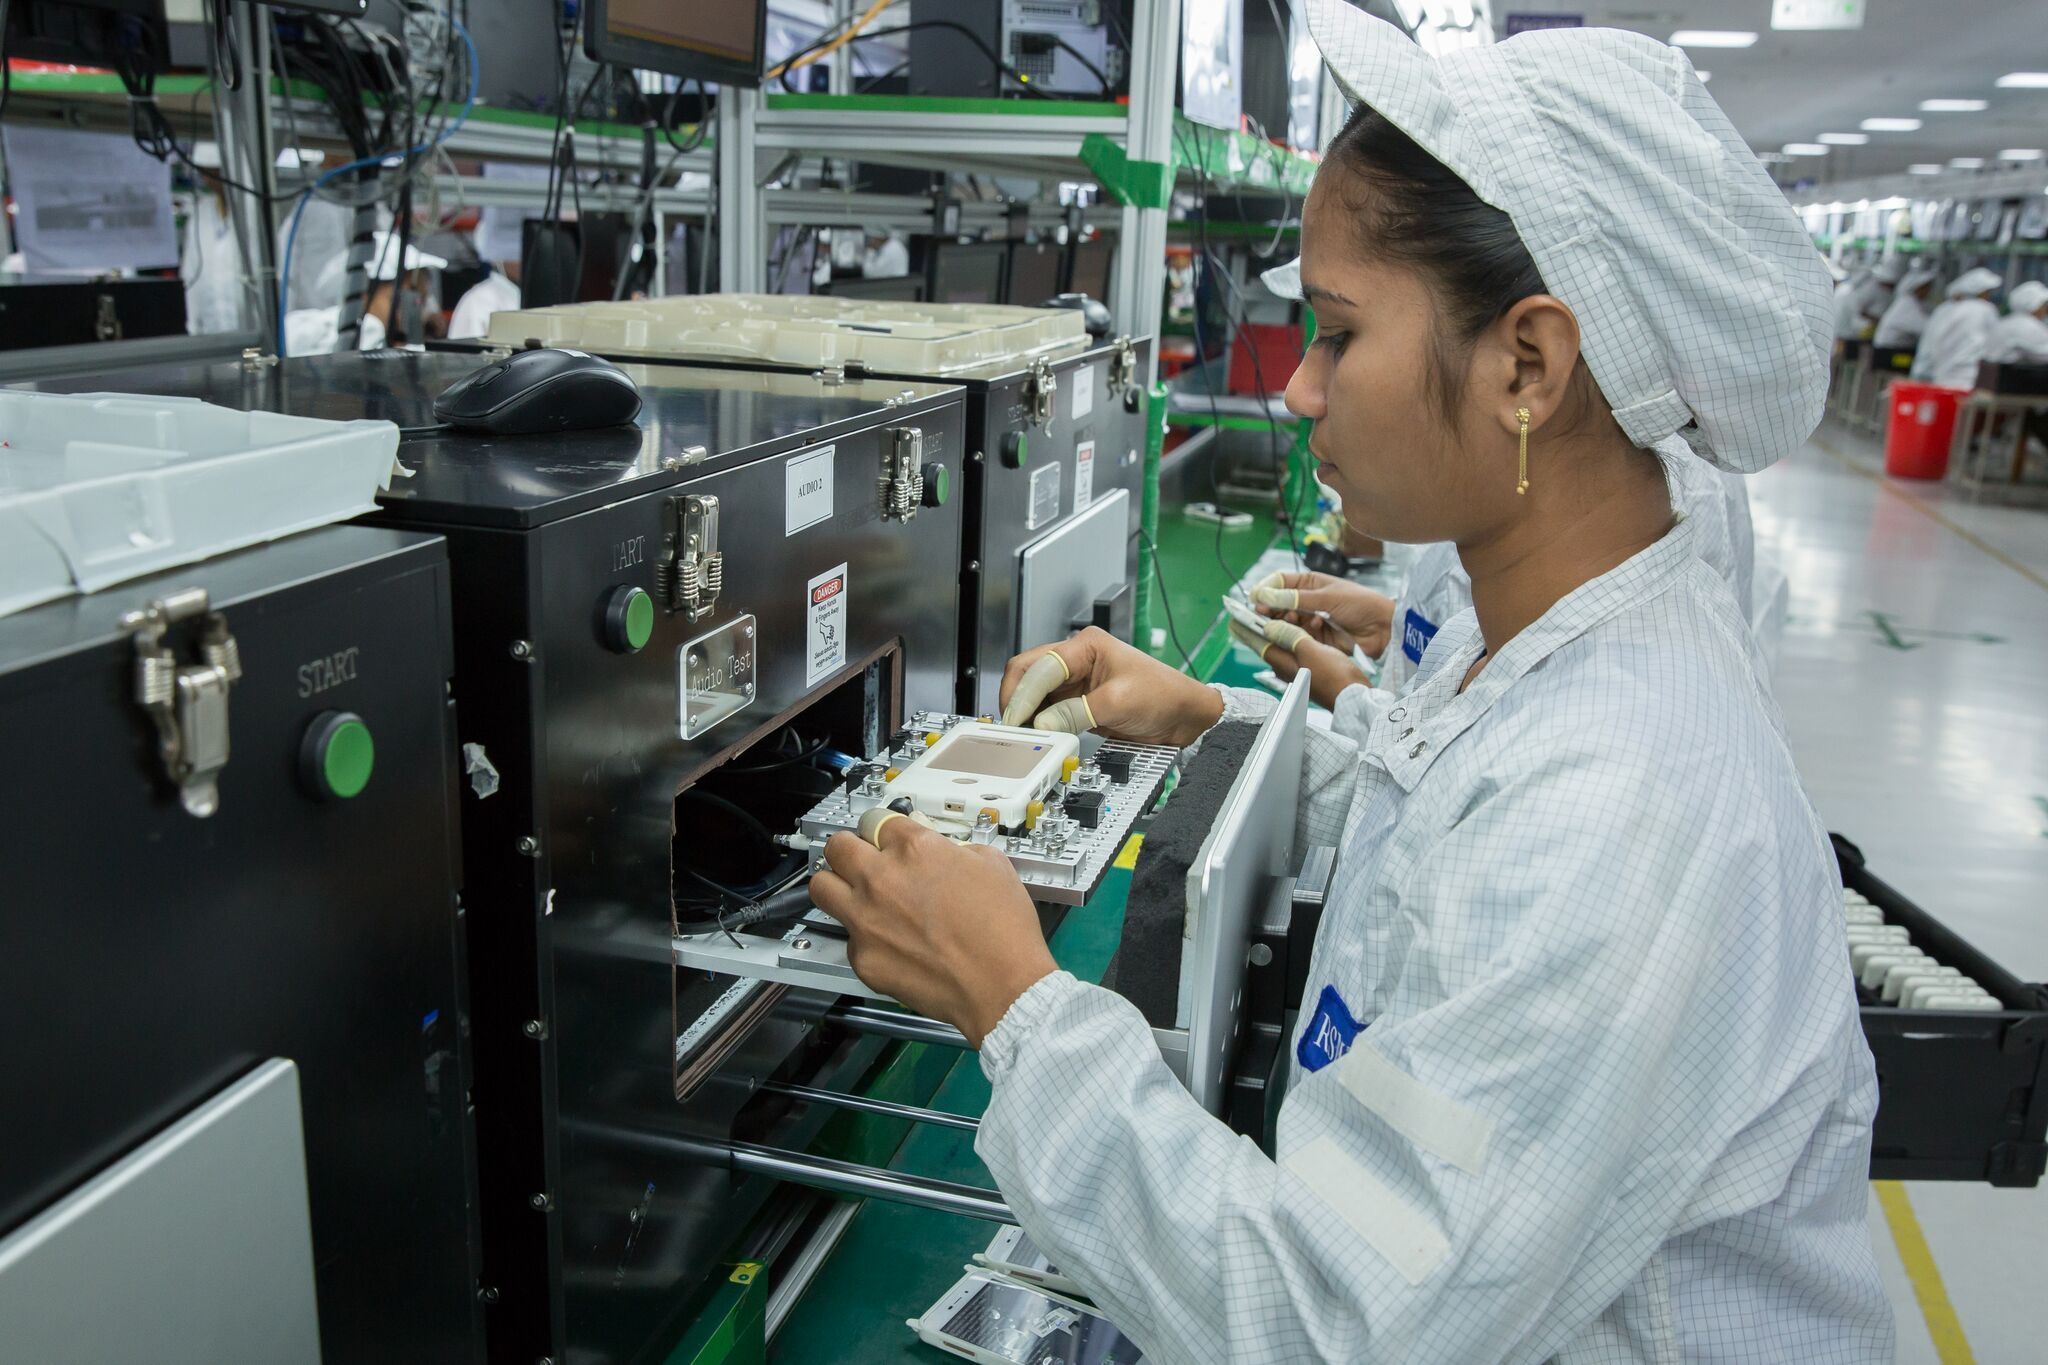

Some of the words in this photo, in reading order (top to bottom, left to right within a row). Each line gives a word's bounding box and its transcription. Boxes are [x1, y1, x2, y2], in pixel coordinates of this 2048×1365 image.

[798, 479, 818, 499] AUDIO
[817, 580, 838, 600] DANGER
[297, 647, 359, 698] START
[691, 666, 723, 699] Audio
[727, 651, 751, 679] Test
